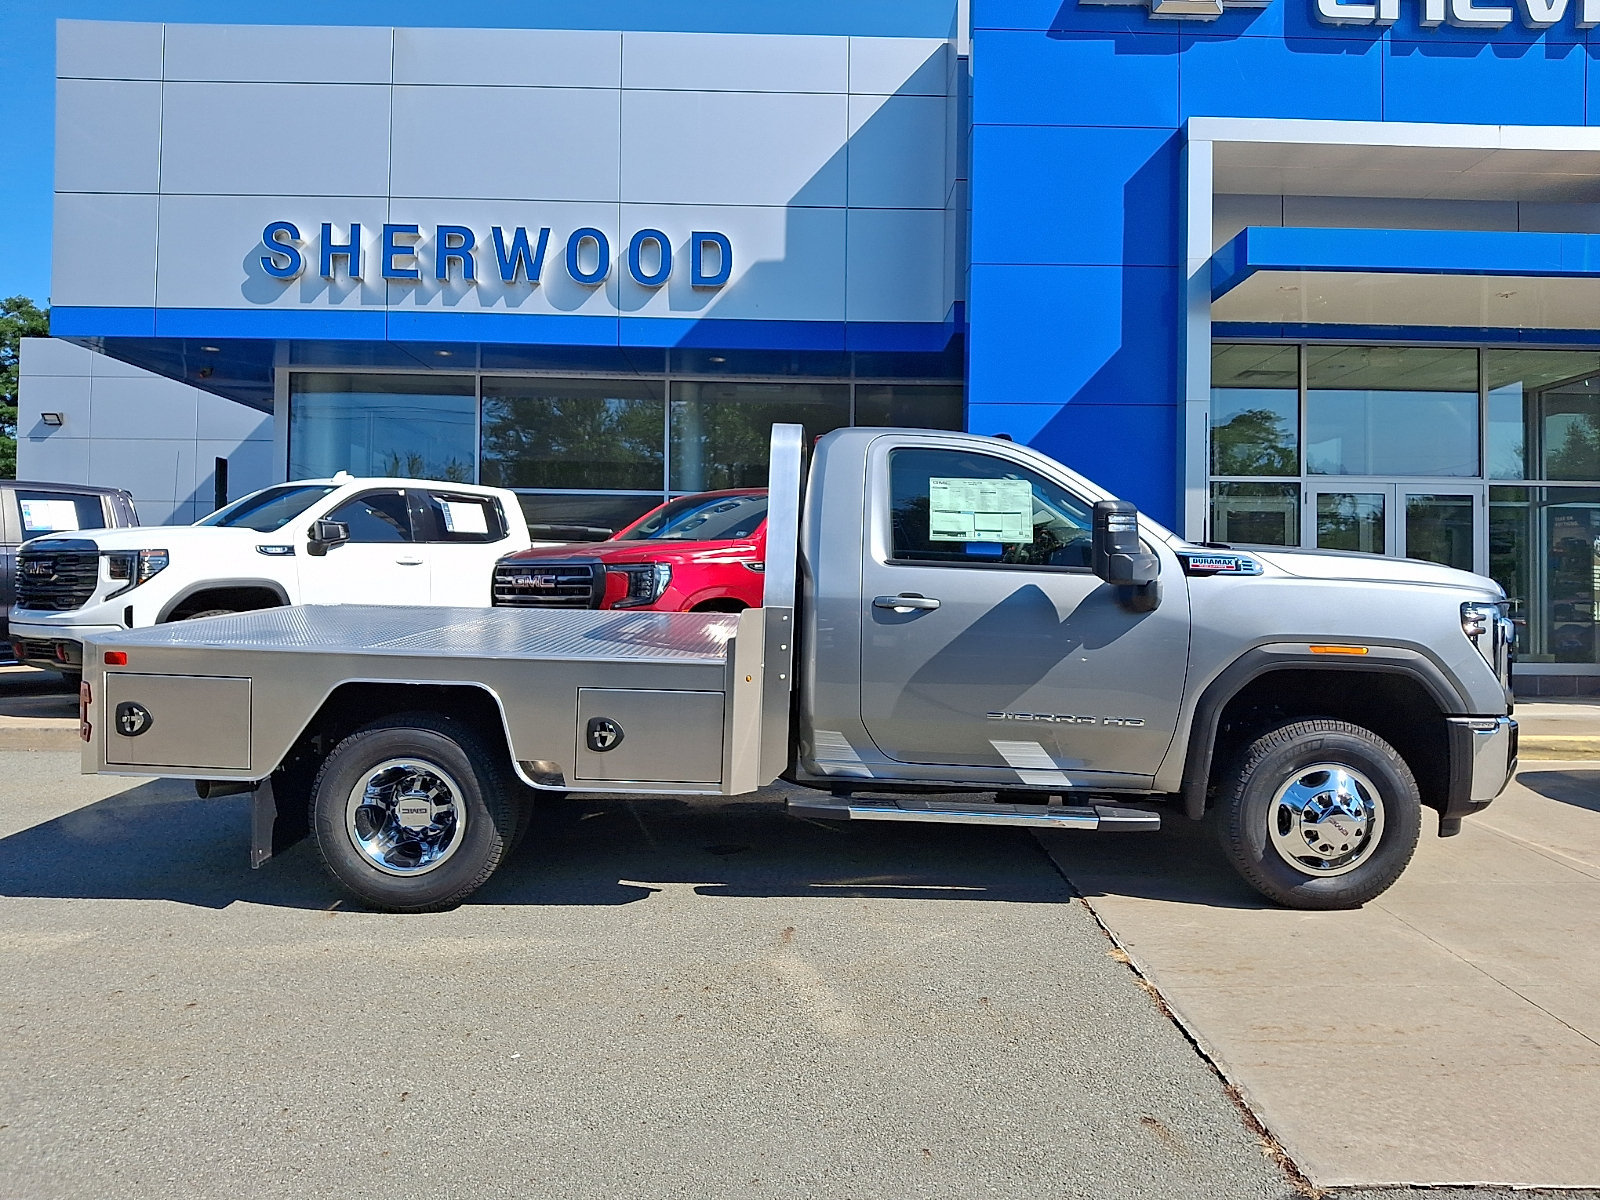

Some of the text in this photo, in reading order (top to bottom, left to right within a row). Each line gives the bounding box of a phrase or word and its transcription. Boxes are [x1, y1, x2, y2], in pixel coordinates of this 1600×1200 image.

[260, 221, 734, 289] SHERWOOD
[512, 575, 556, 588] GMC
[986, 711, 1146, 727] SIERRA HD
